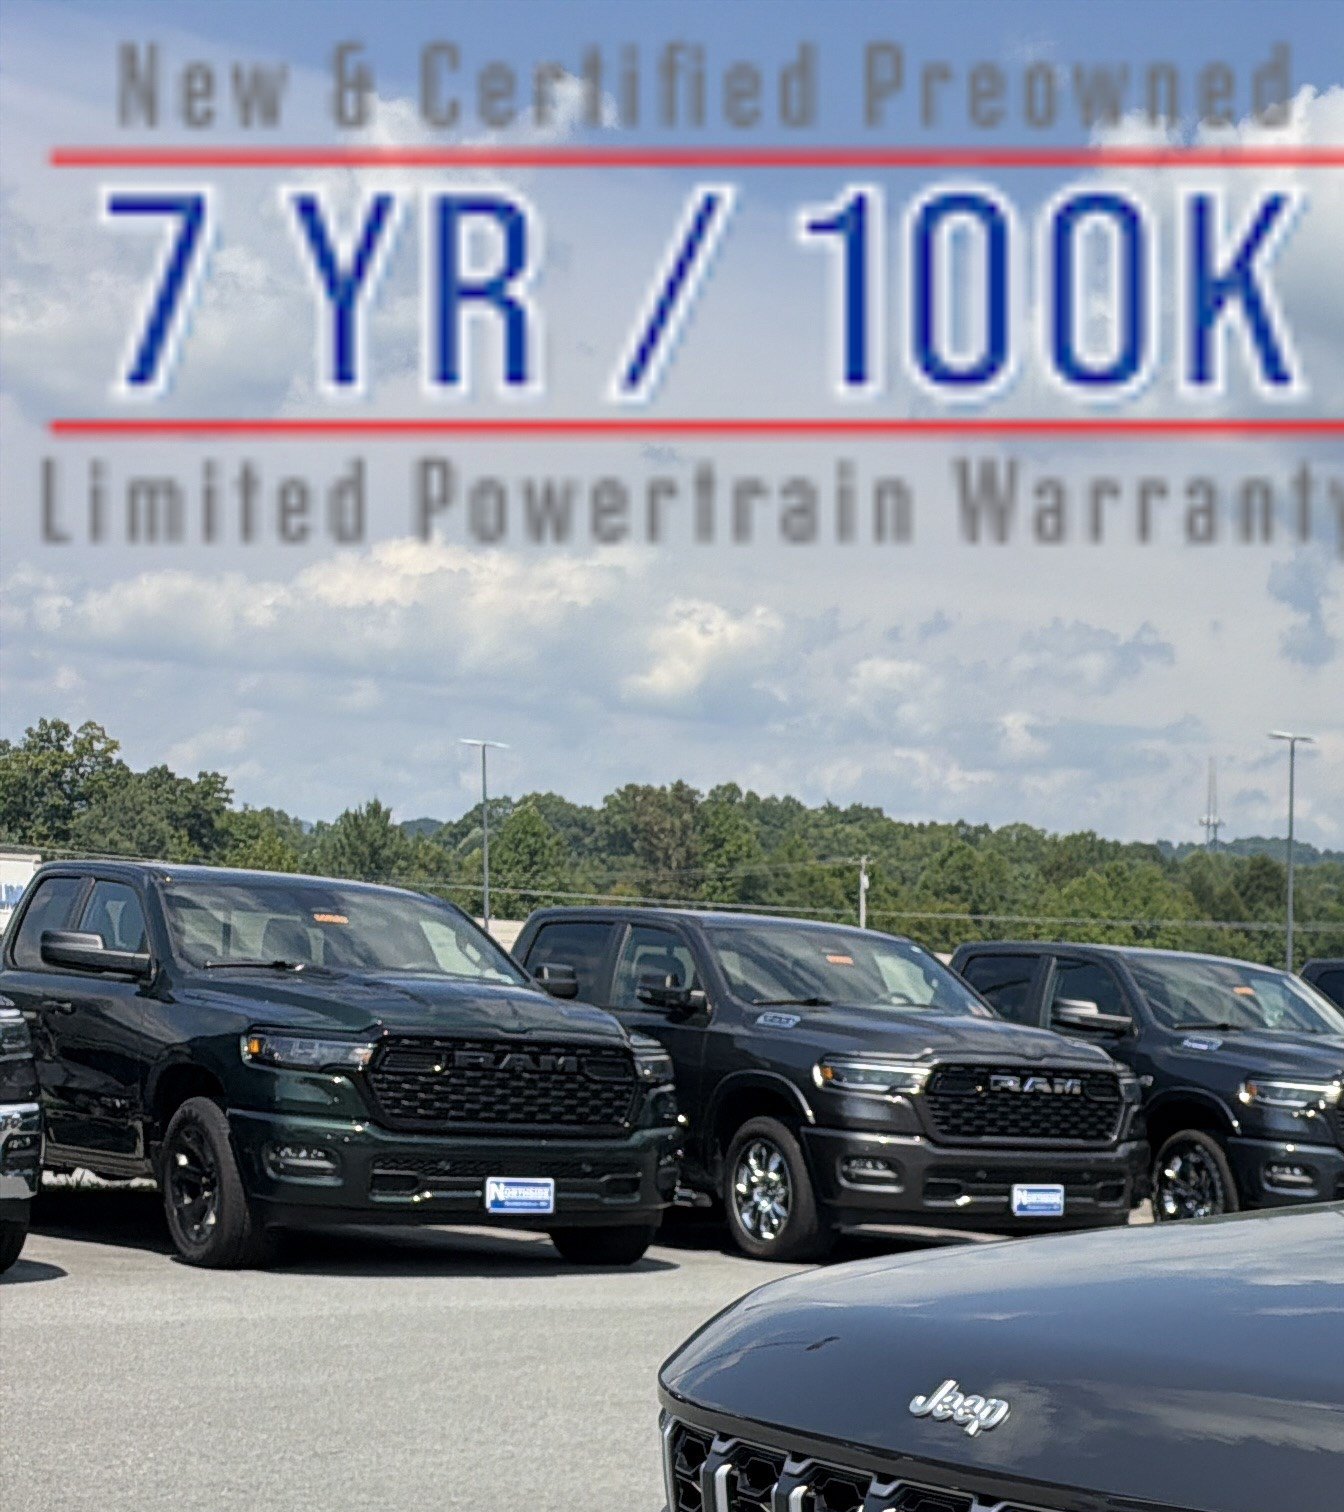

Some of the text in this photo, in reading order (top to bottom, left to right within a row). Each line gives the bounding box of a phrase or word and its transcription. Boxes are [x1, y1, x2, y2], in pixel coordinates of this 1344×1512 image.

[454, 1051, 577, 1072] RAM
[990, 1074, 1082, 1095] RAM
[909, 1379, 1010, 1437] Jeep
